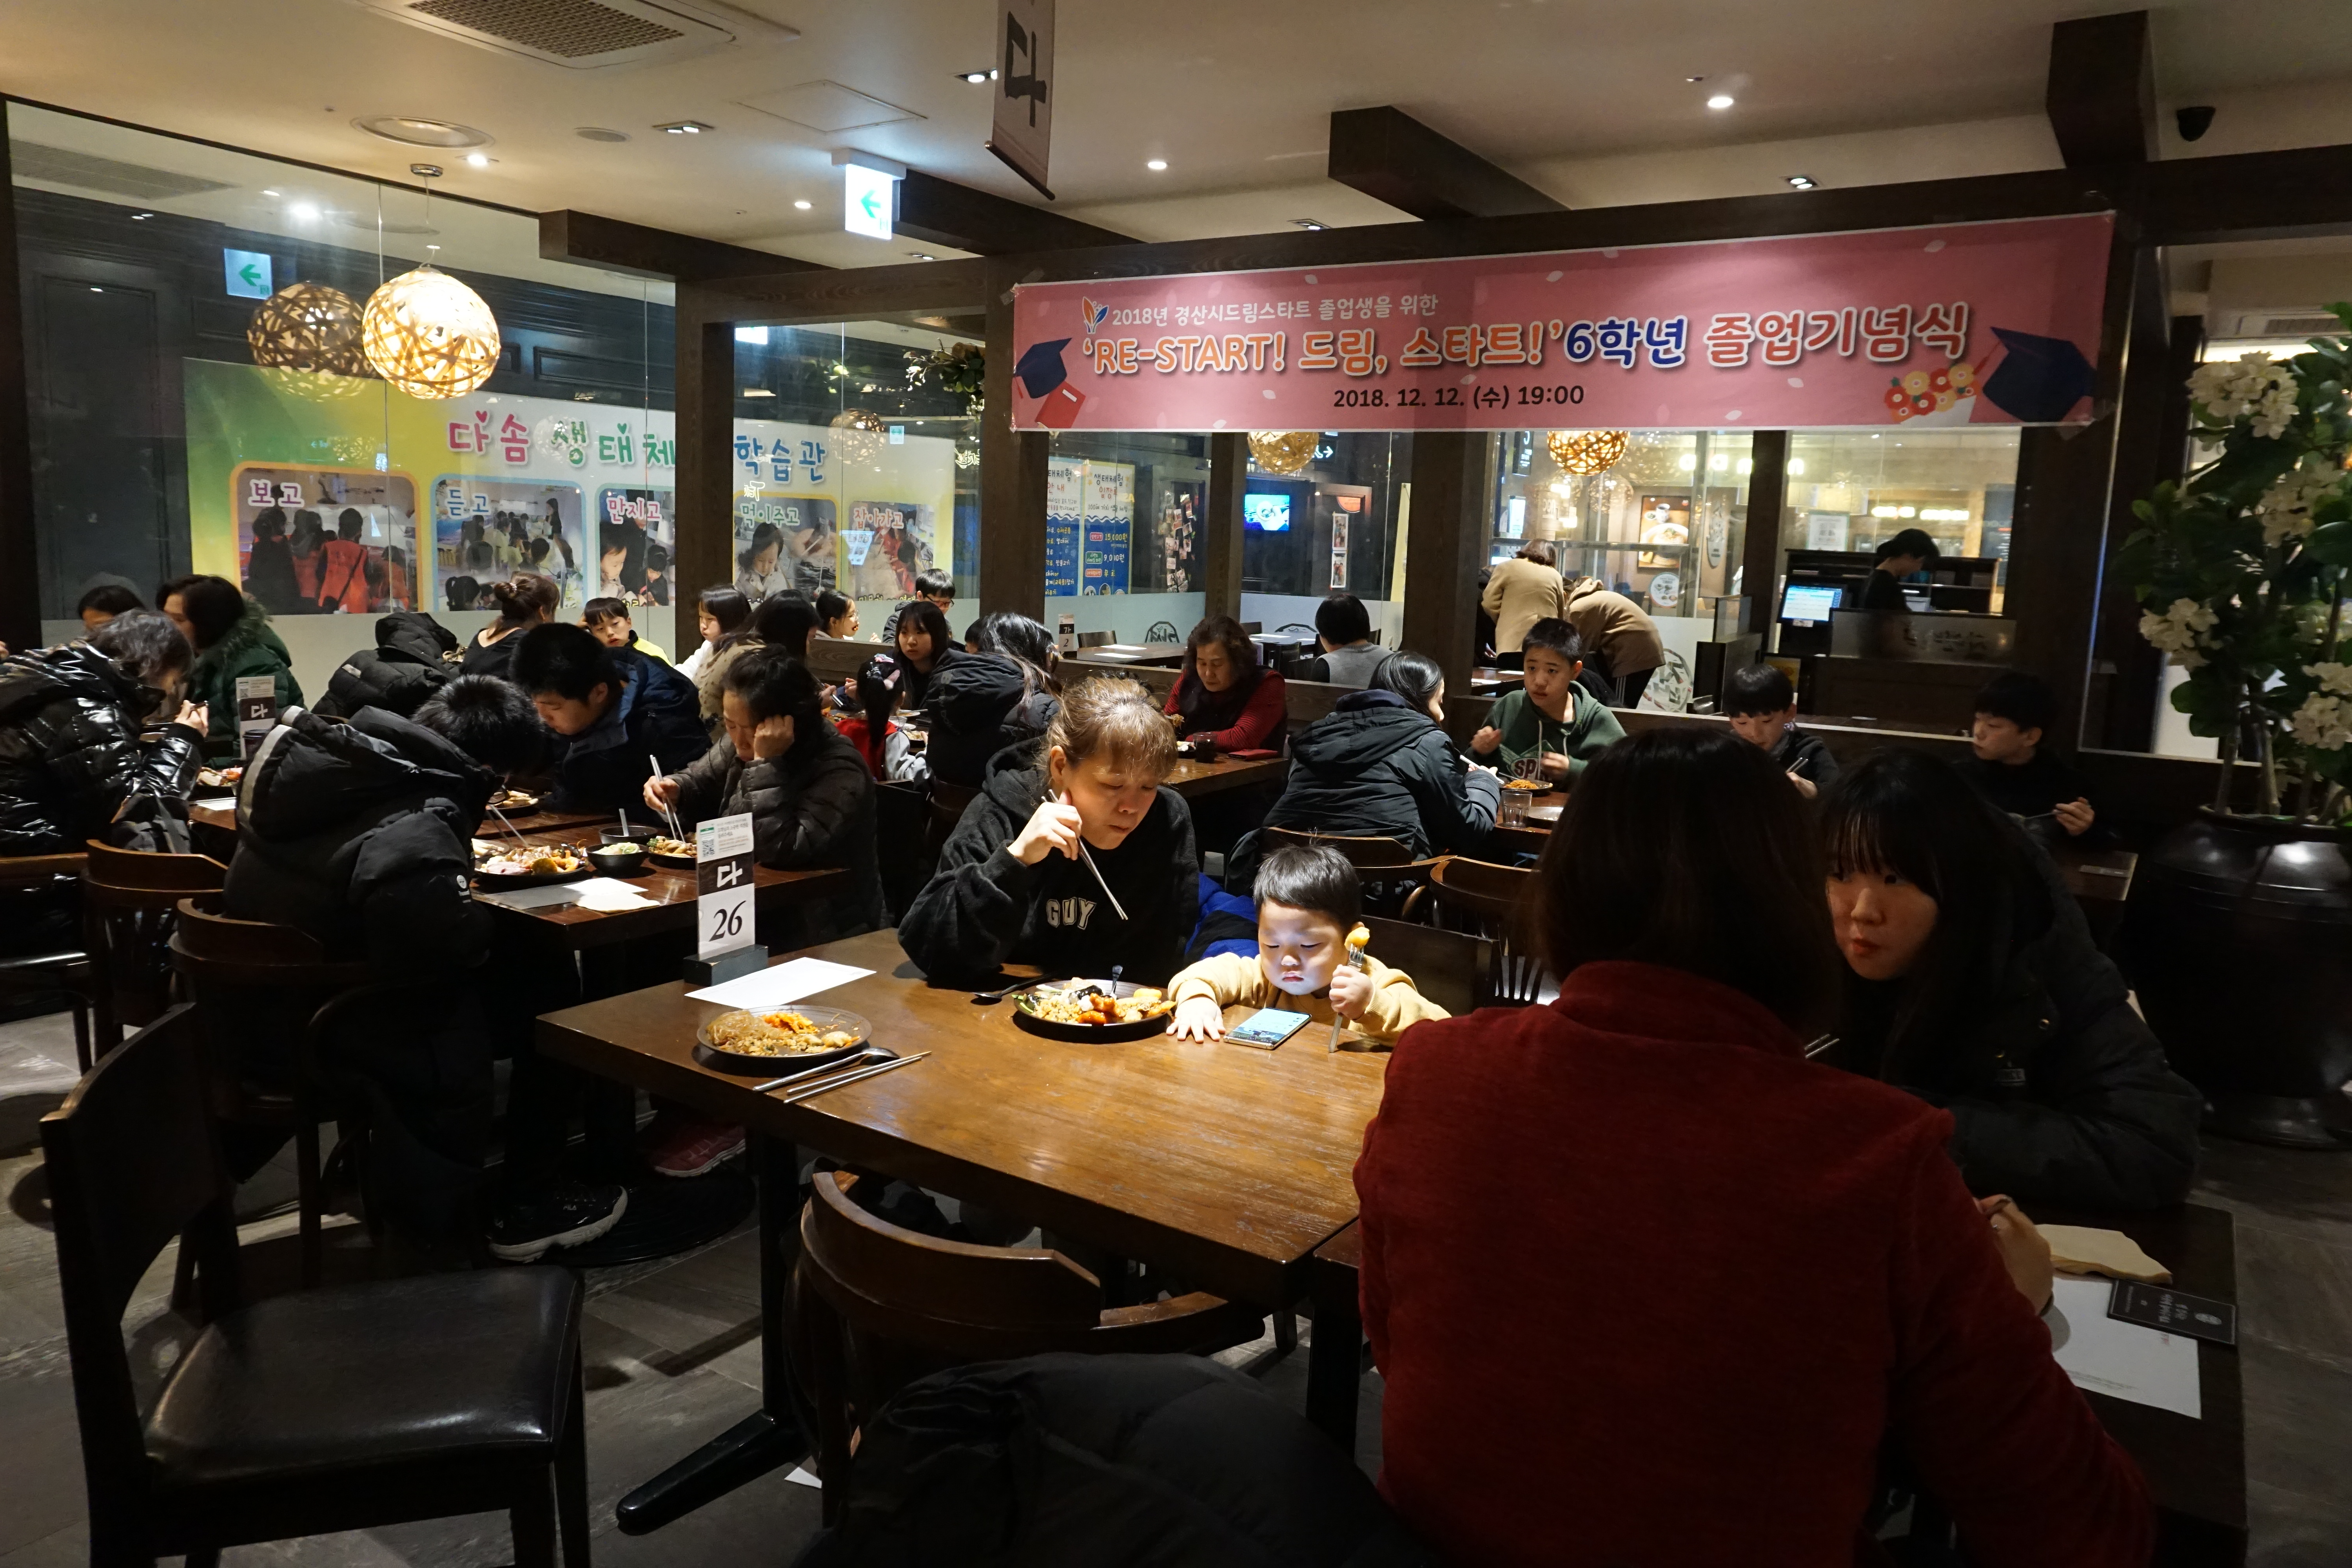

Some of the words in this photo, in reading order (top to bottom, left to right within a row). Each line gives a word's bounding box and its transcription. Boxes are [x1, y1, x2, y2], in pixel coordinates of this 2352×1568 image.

[1004, 11, 1047, 128] 다
[1112, 307, 1168, 327] 2018년
[1175, 302, 1311, 327] 경산시드림스타트
[1318, 296, 1392, 320] 졸업생을
[1399, 294, 1438, 316] 위한
[1299, 328, 1387, 376] 드림,
[1704, 301, 1968, 367] 졸업기념식
[1334, 389, 1388, 407] 2018.
[1398, 388, 1426, 407] 12.
[1435, 388, 1464, 406] 12.
[1474, 386, 1509, 408] (수)
[1518, 385, 1584, 405] 19:00
[448, 412, 530, 465] 다솜
[733, 435, 826, 484] 학습관
[248, 479, 304, 508] 보고
[1094, 473, 1123, 486] 생태체험
[445, 487, 491, 519] 듣고
[606, 495, 662, 524] 만지고
[741, 502, 800, 528] 먹이주고
[853, 507, 904, 530] 잡아가고
[1063, 638, 1069, 647] 2
[251, 704, 268, 718] 다
[717, 861, 743, 888] 다
[709, 900, 747, 942] 26
[1046, 897, 1097, 930] GUY
